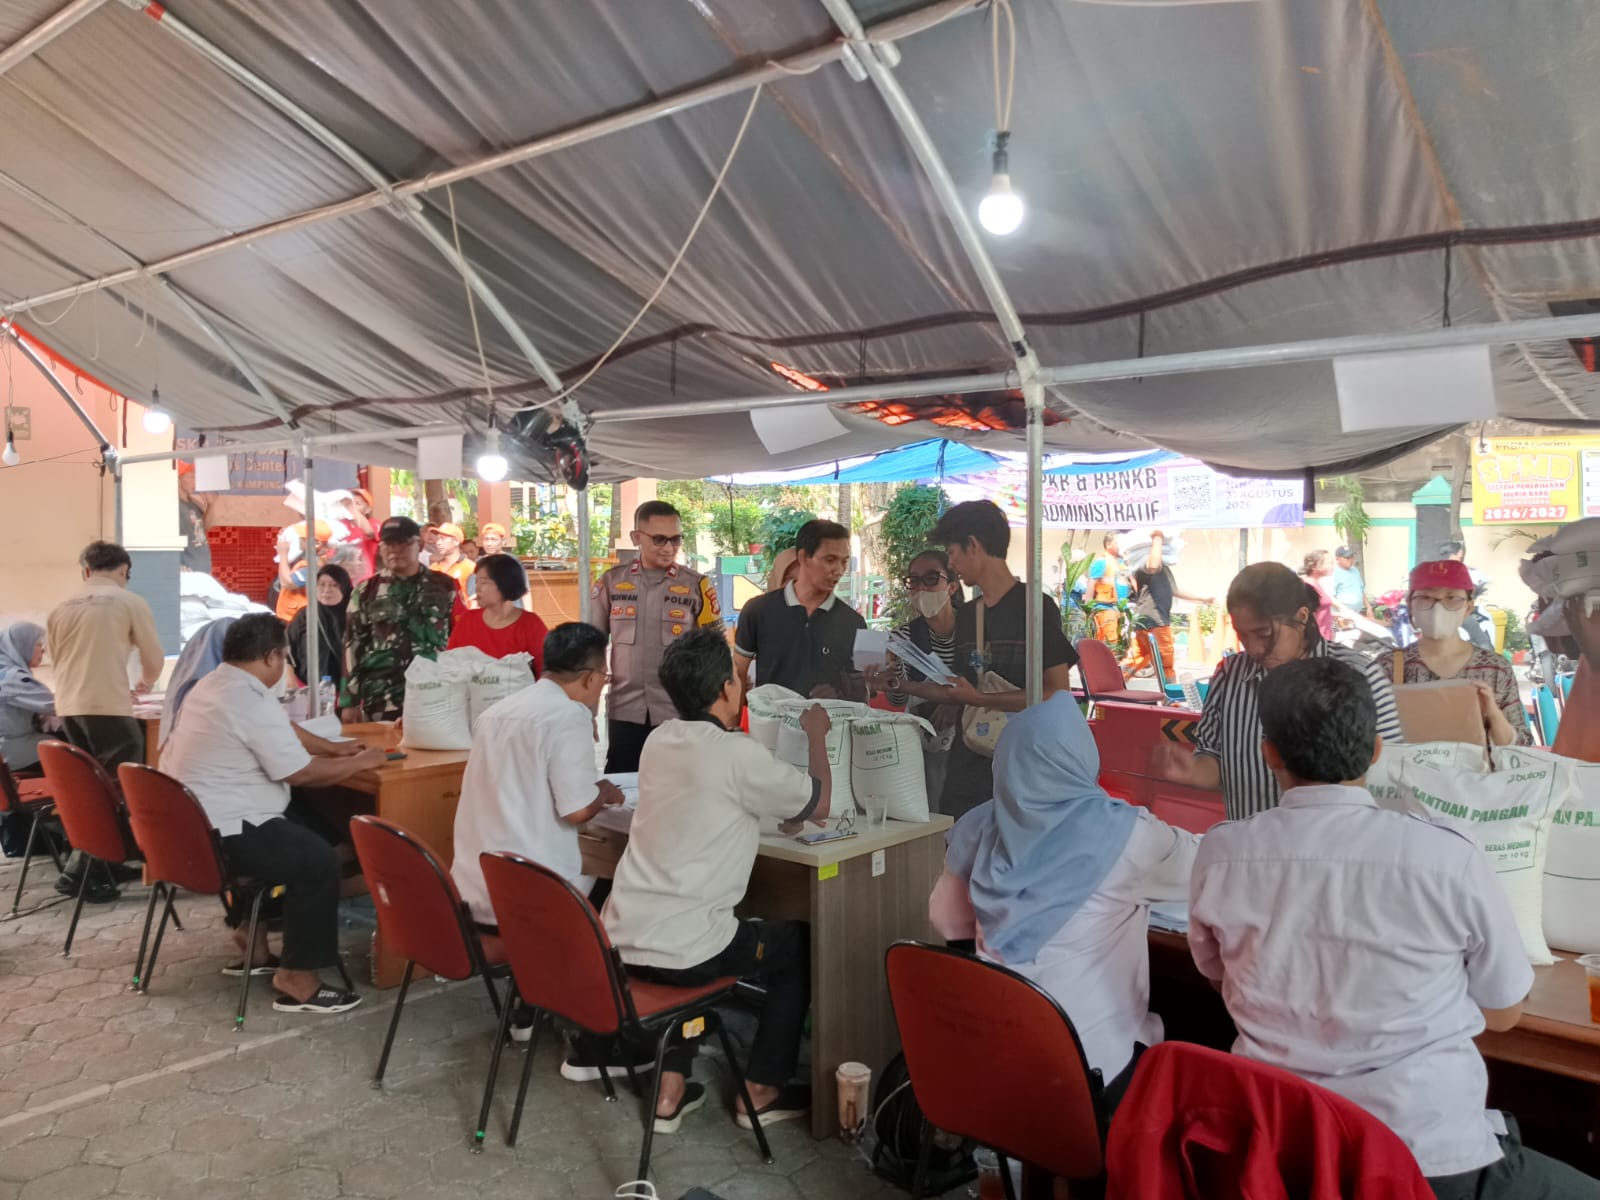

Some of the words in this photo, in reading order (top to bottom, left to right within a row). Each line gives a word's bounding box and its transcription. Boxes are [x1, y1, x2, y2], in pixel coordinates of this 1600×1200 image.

[1477, 454, 1575, 484] SPMB
[1239, 488, 1294, 499] AGUSTUS
[1042, 500, 1160, 523] ADMINISTRATIF
[1484, 507, 1567, 520] 2026/2027
[664, 595, 693, 607] POLRI
[1412, 785, 1469, 819] BANTUAN
[1470, 804, 1529, 823] PANGAN
